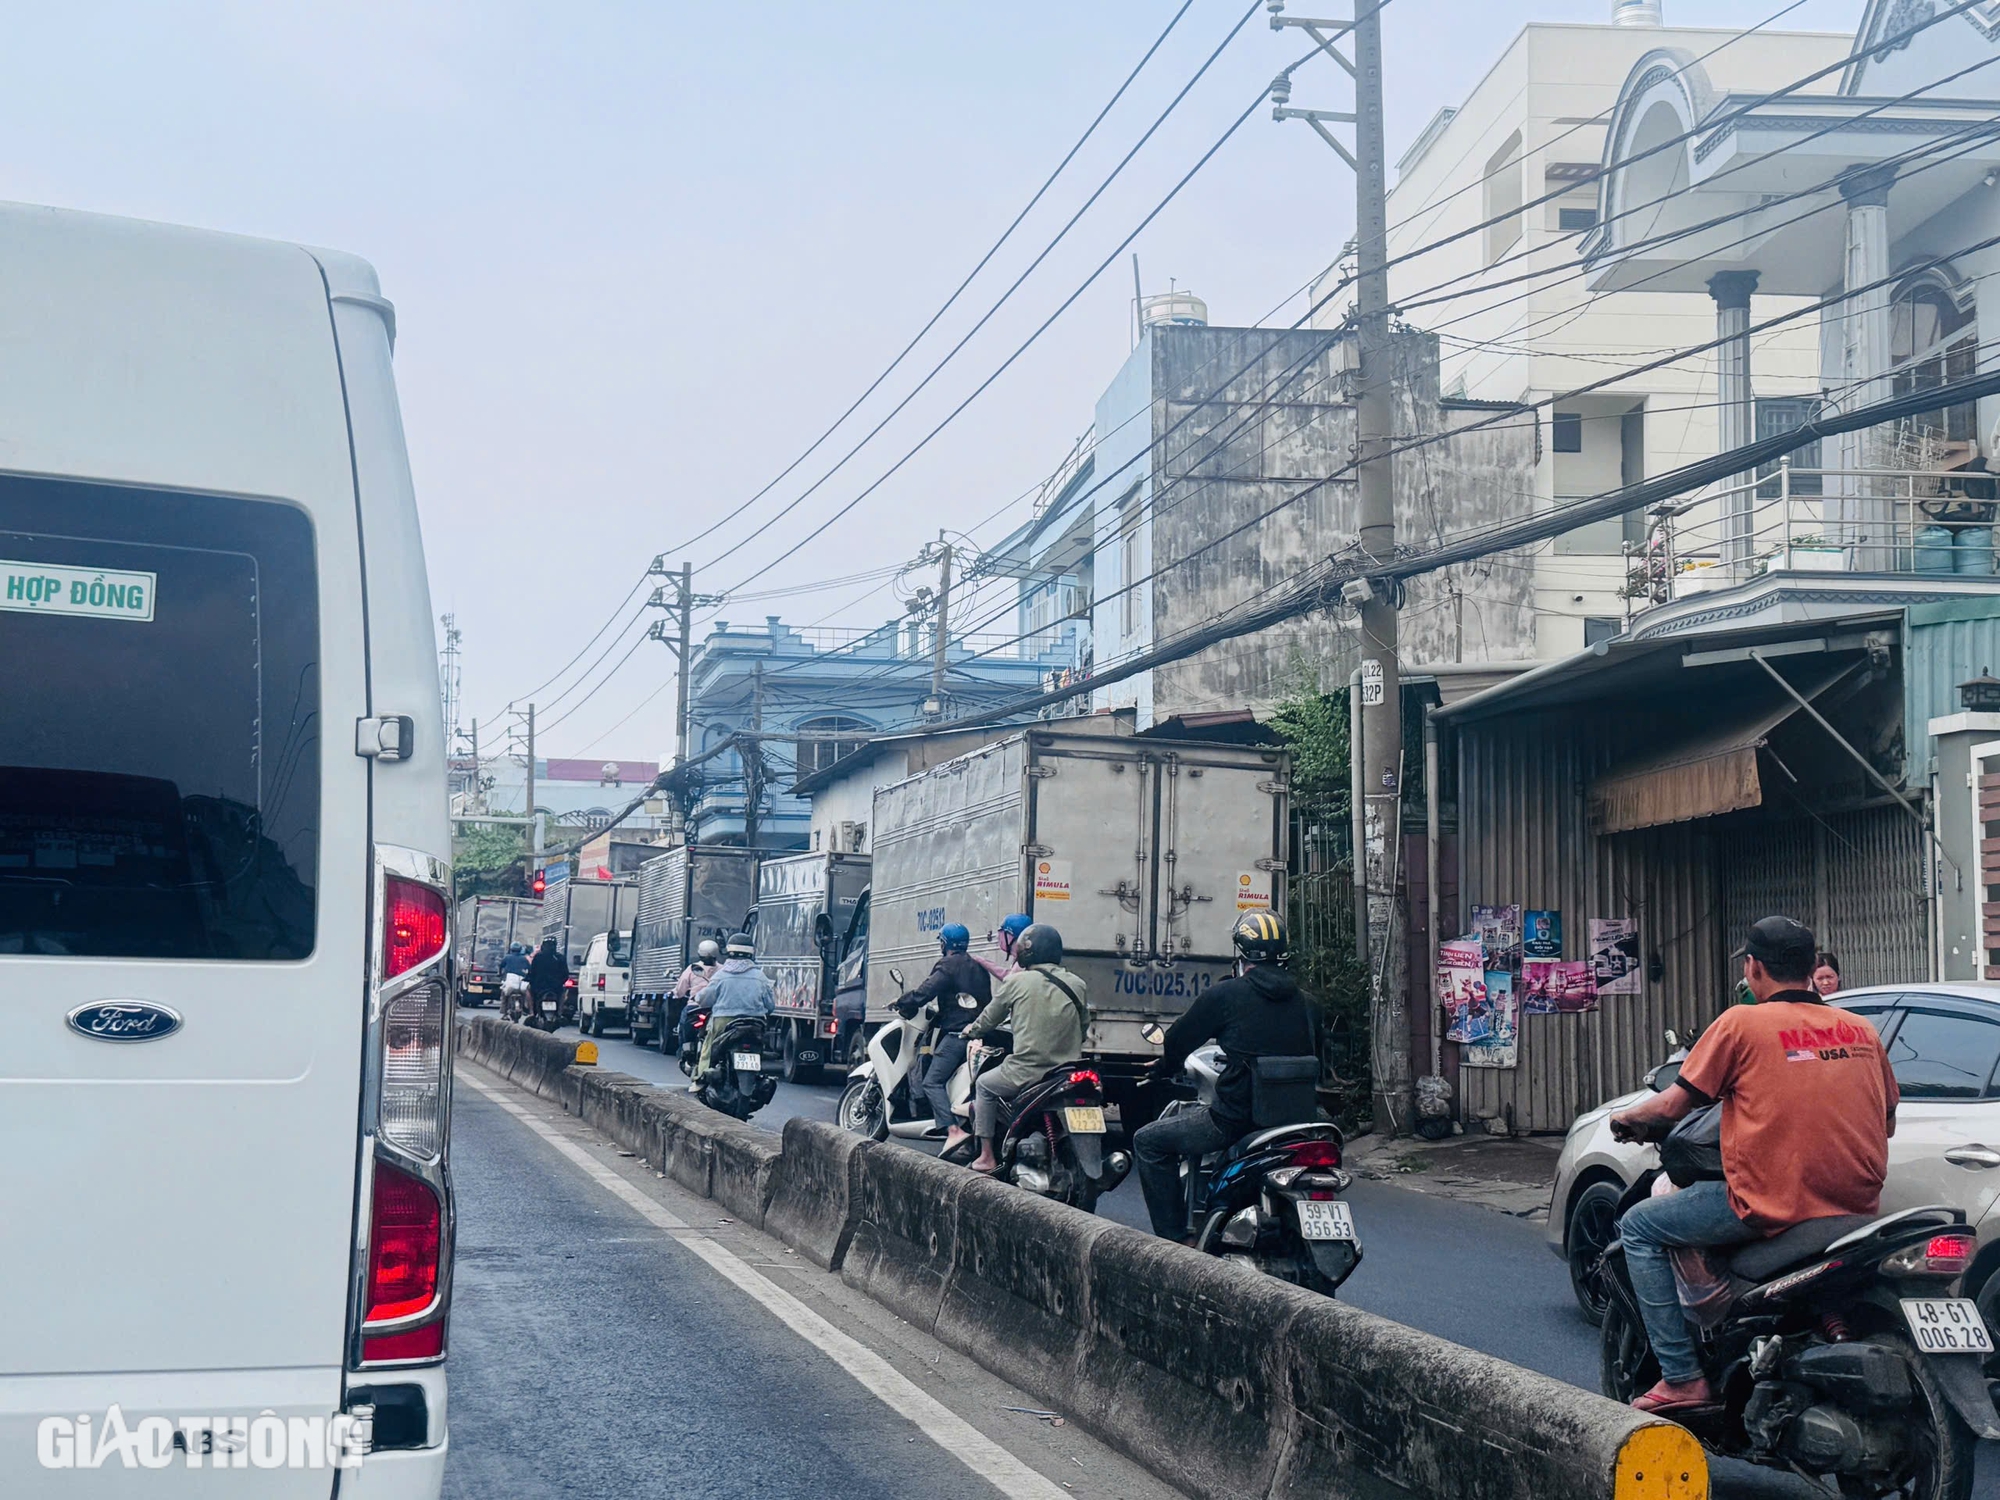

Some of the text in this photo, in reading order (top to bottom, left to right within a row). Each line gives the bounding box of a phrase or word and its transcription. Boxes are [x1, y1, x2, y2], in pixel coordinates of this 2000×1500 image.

[7, 574, 144, 610] HỢP ĐỒNG
[1036, 880, 1070, 889] RIMULA
[841, 897, 859, 905] THA
[1238, 892, 1269, 900] RIMULA
[91, 1006, 158, 1032] Ford
[802, 1052, 816, 1060] KIA
[1819, 1047, 1850, 1061] USA
[1305, 1203, 1342, 1220] 59-V1
[1304, 1220, 1351, 1238] 356.53
[1915, 1302, 1971, 1323] 48-G1
[1920, 1326, 1987, 1348] 006.28
